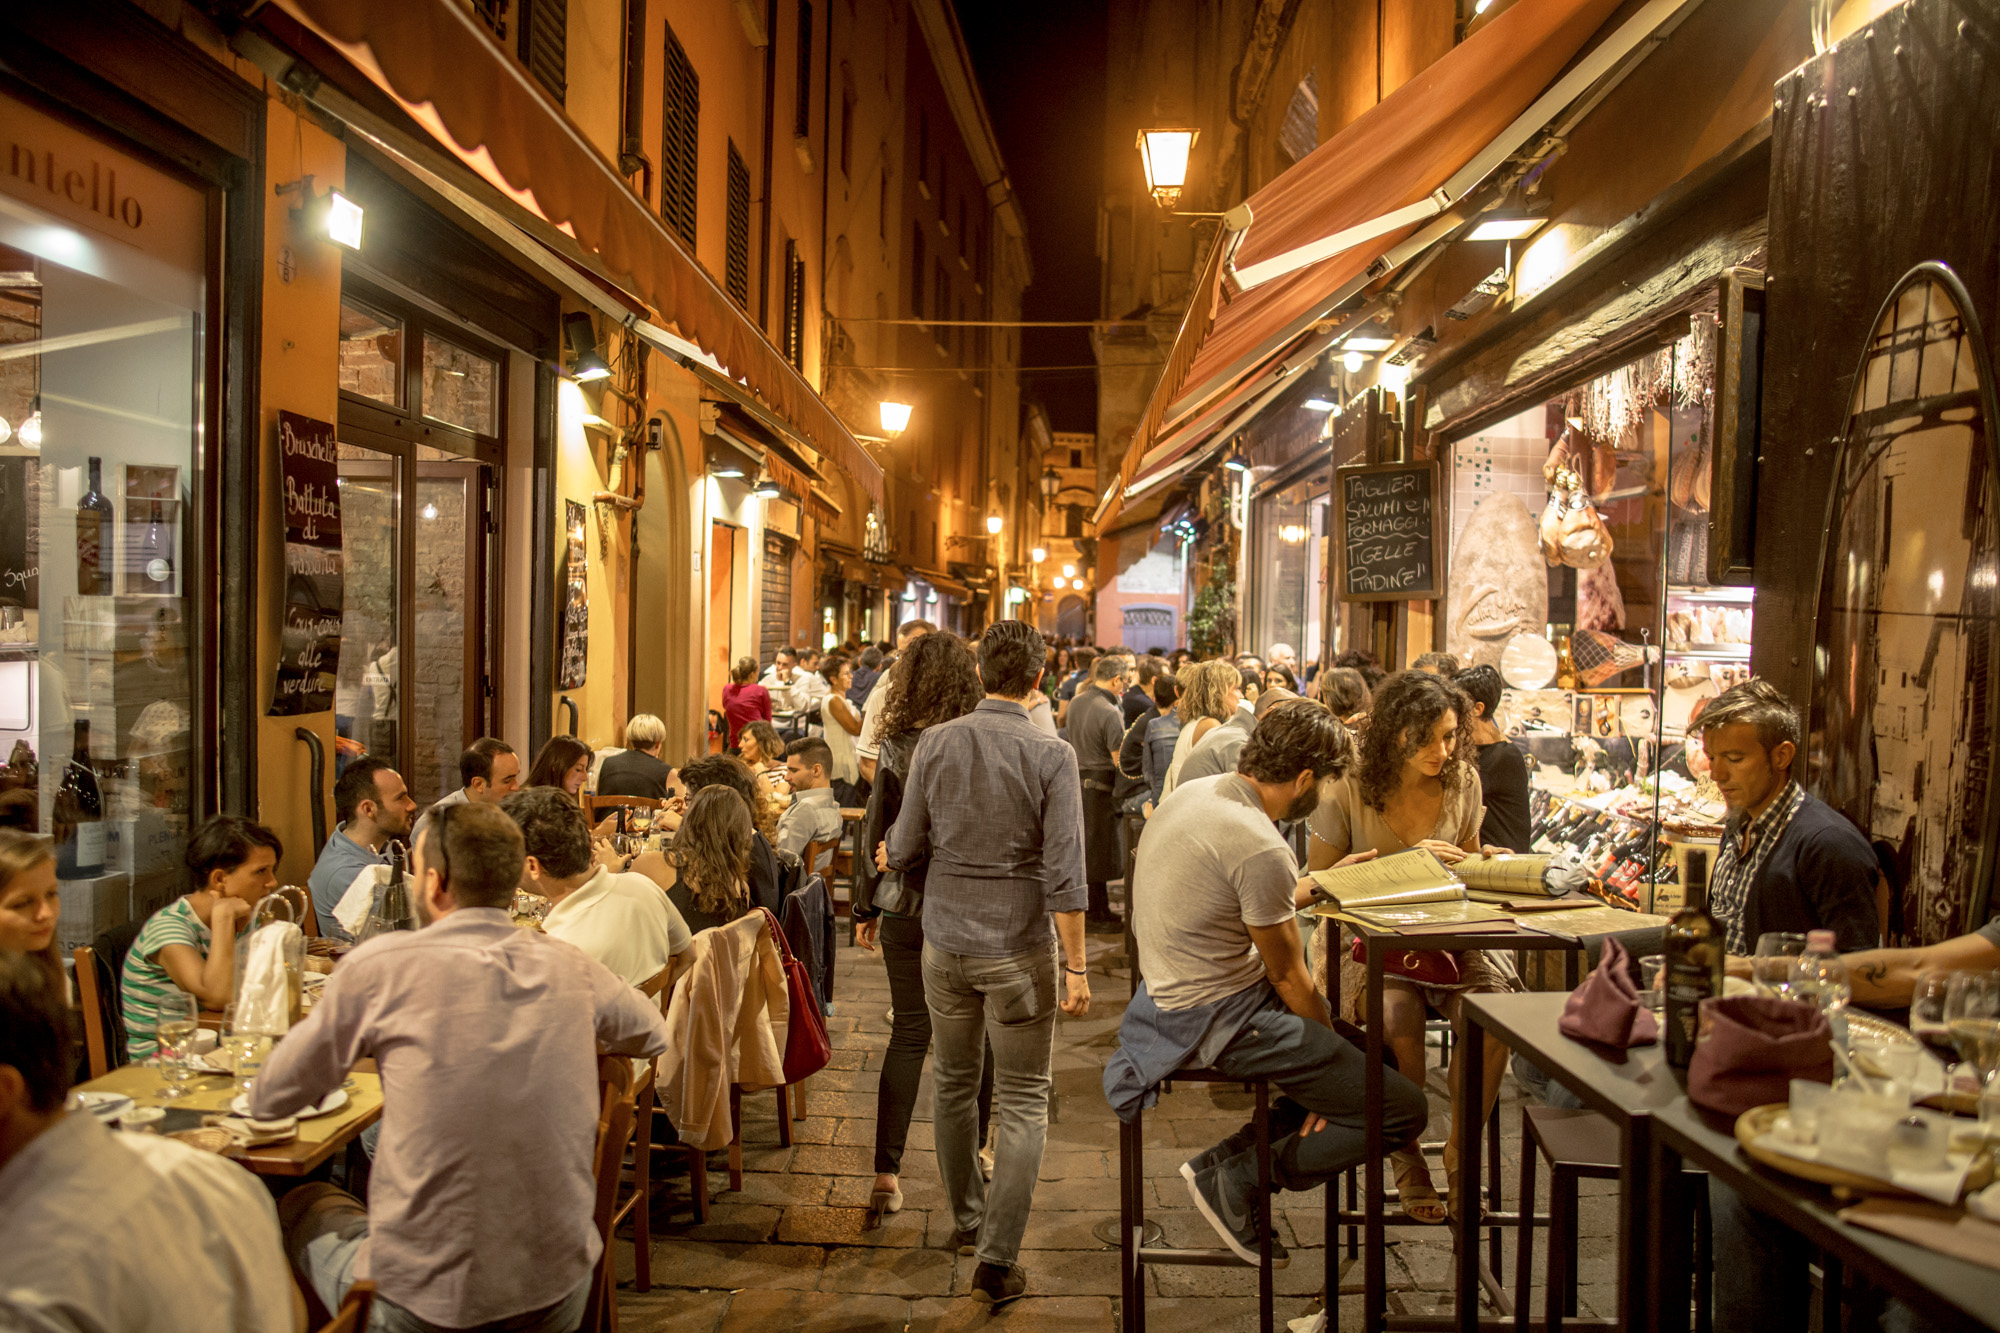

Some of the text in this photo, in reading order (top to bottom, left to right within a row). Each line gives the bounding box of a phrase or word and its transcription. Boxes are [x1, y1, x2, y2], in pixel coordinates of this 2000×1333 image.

[2, 142, 143, 229] ntello
[286, 475, 337, 520] Battuta
[1346, 474, 1420, 499] TAGLIERI
[1346, 499, 1421, 521] SALUMI e
[302, 517, 320, 541] di
[1347, 541, 1418, 567] TIGELLE
[298, 639, 322, 667] alle
[283, 673, 327, 695] verdure
